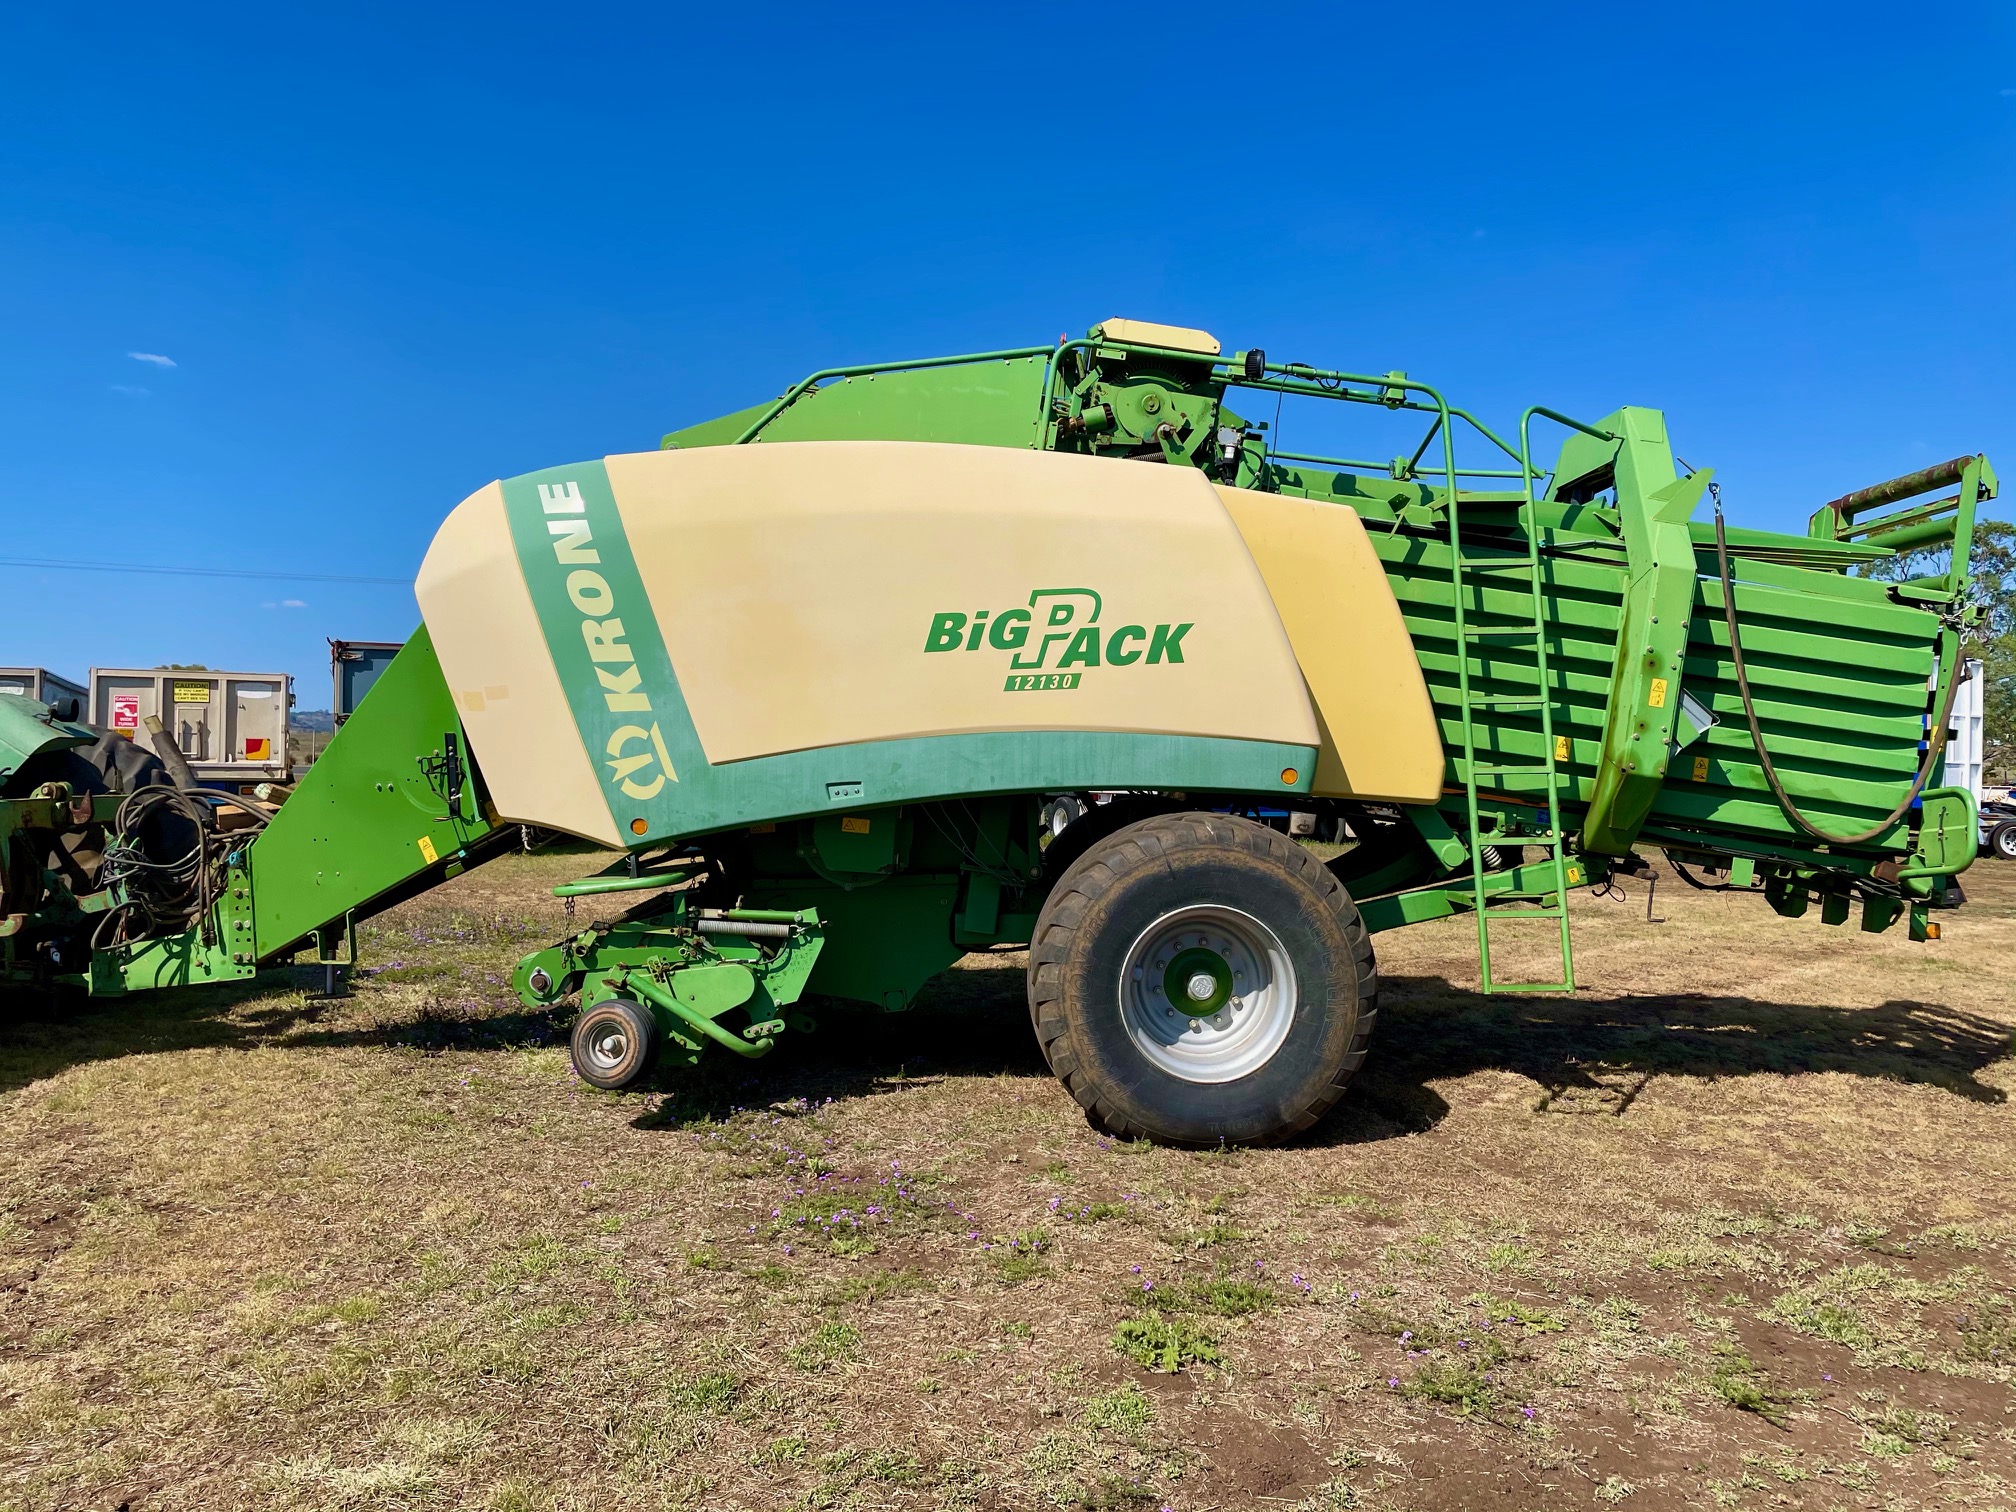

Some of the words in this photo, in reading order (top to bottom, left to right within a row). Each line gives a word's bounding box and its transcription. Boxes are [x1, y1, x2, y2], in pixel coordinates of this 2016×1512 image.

[537, 481, 653, 712] KRONE
[1013, 674, 1073, 690] 12130
[1083, 907, 1109, 941] PRO
